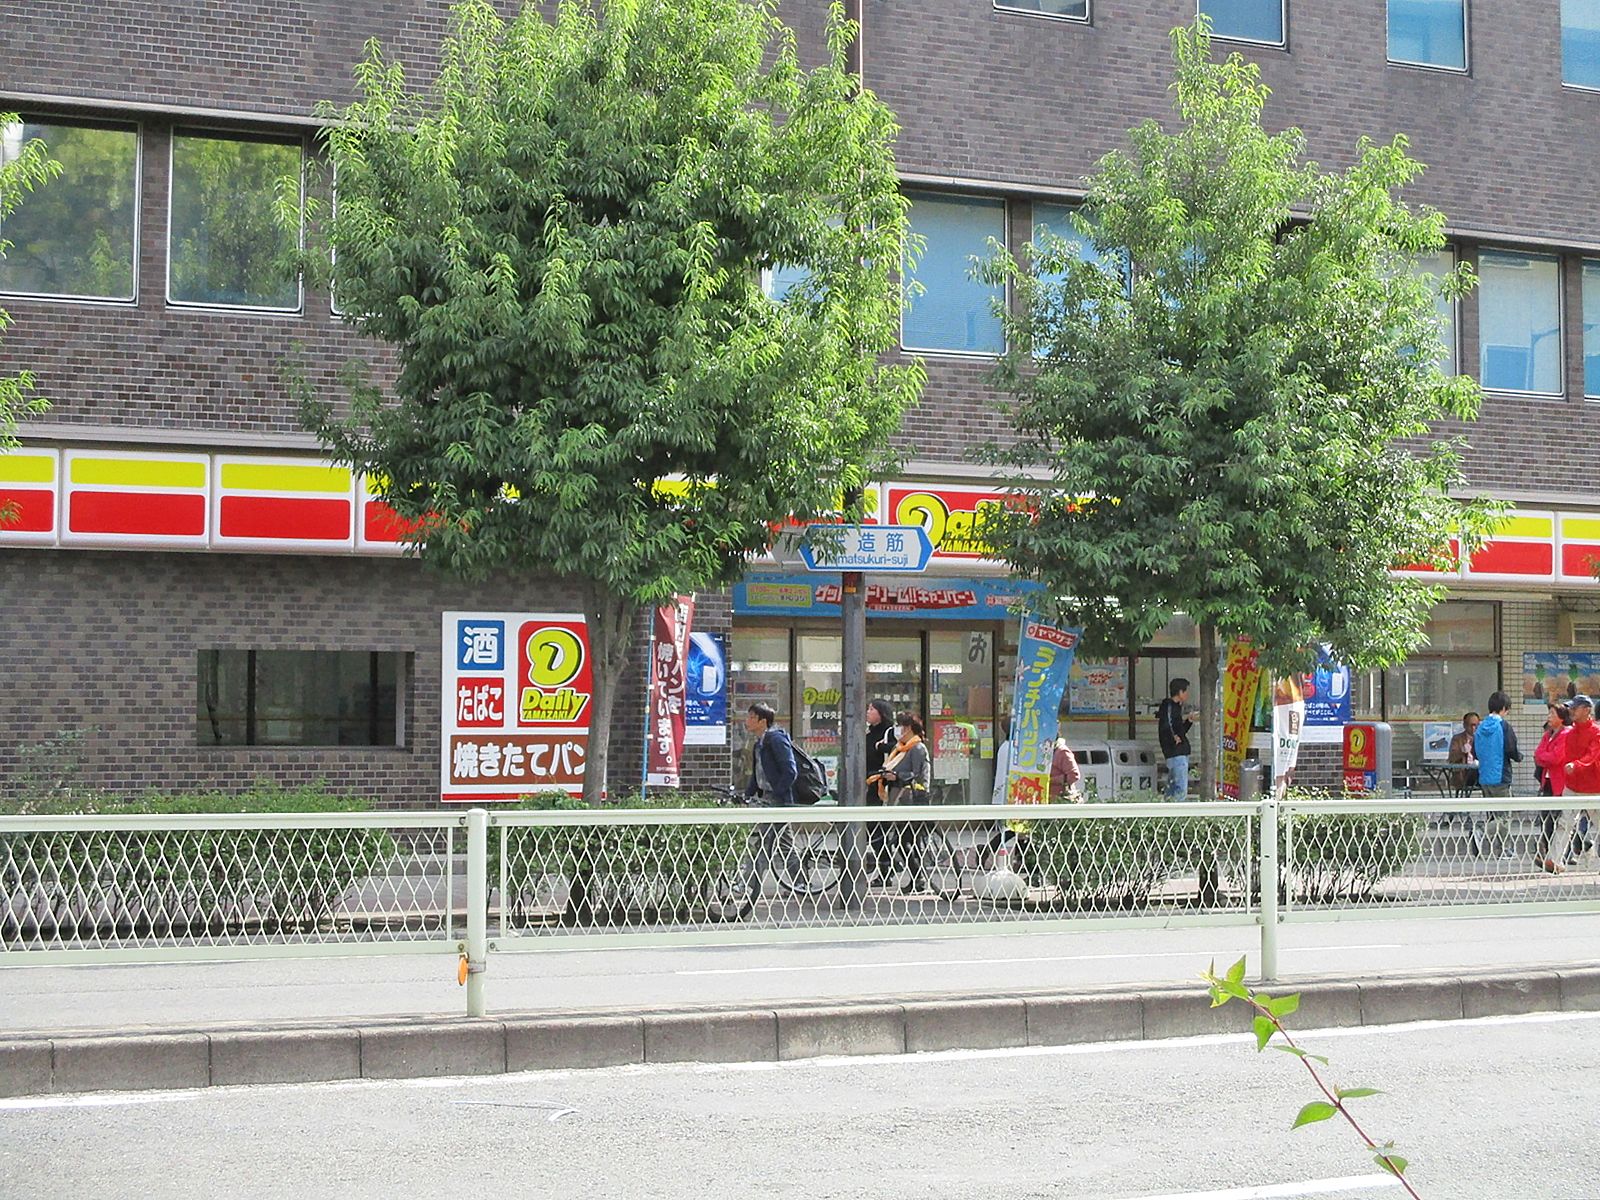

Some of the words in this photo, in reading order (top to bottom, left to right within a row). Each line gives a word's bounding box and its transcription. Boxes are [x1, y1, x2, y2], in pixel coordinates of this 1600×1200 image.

[826, 553, 909, 567] matsukuri-suji
[462, 626, 500, 665] 酒
[1037, 628, 1075, 647] ヤマザキ
[458, 683, 503, 721] たばこ
[521, 688, 589, 720] Daily
[656, 641, 674, 764] 焼いています。
[802, 687, 843, 705] Daily
[1019, 646, 1056, 767] ランチパック
[522, 710, 568, 720] YAMAZAKI
[453, 741, 586, 778] 焼きたてパン
[1348, 753, 1368, 767] Daily
